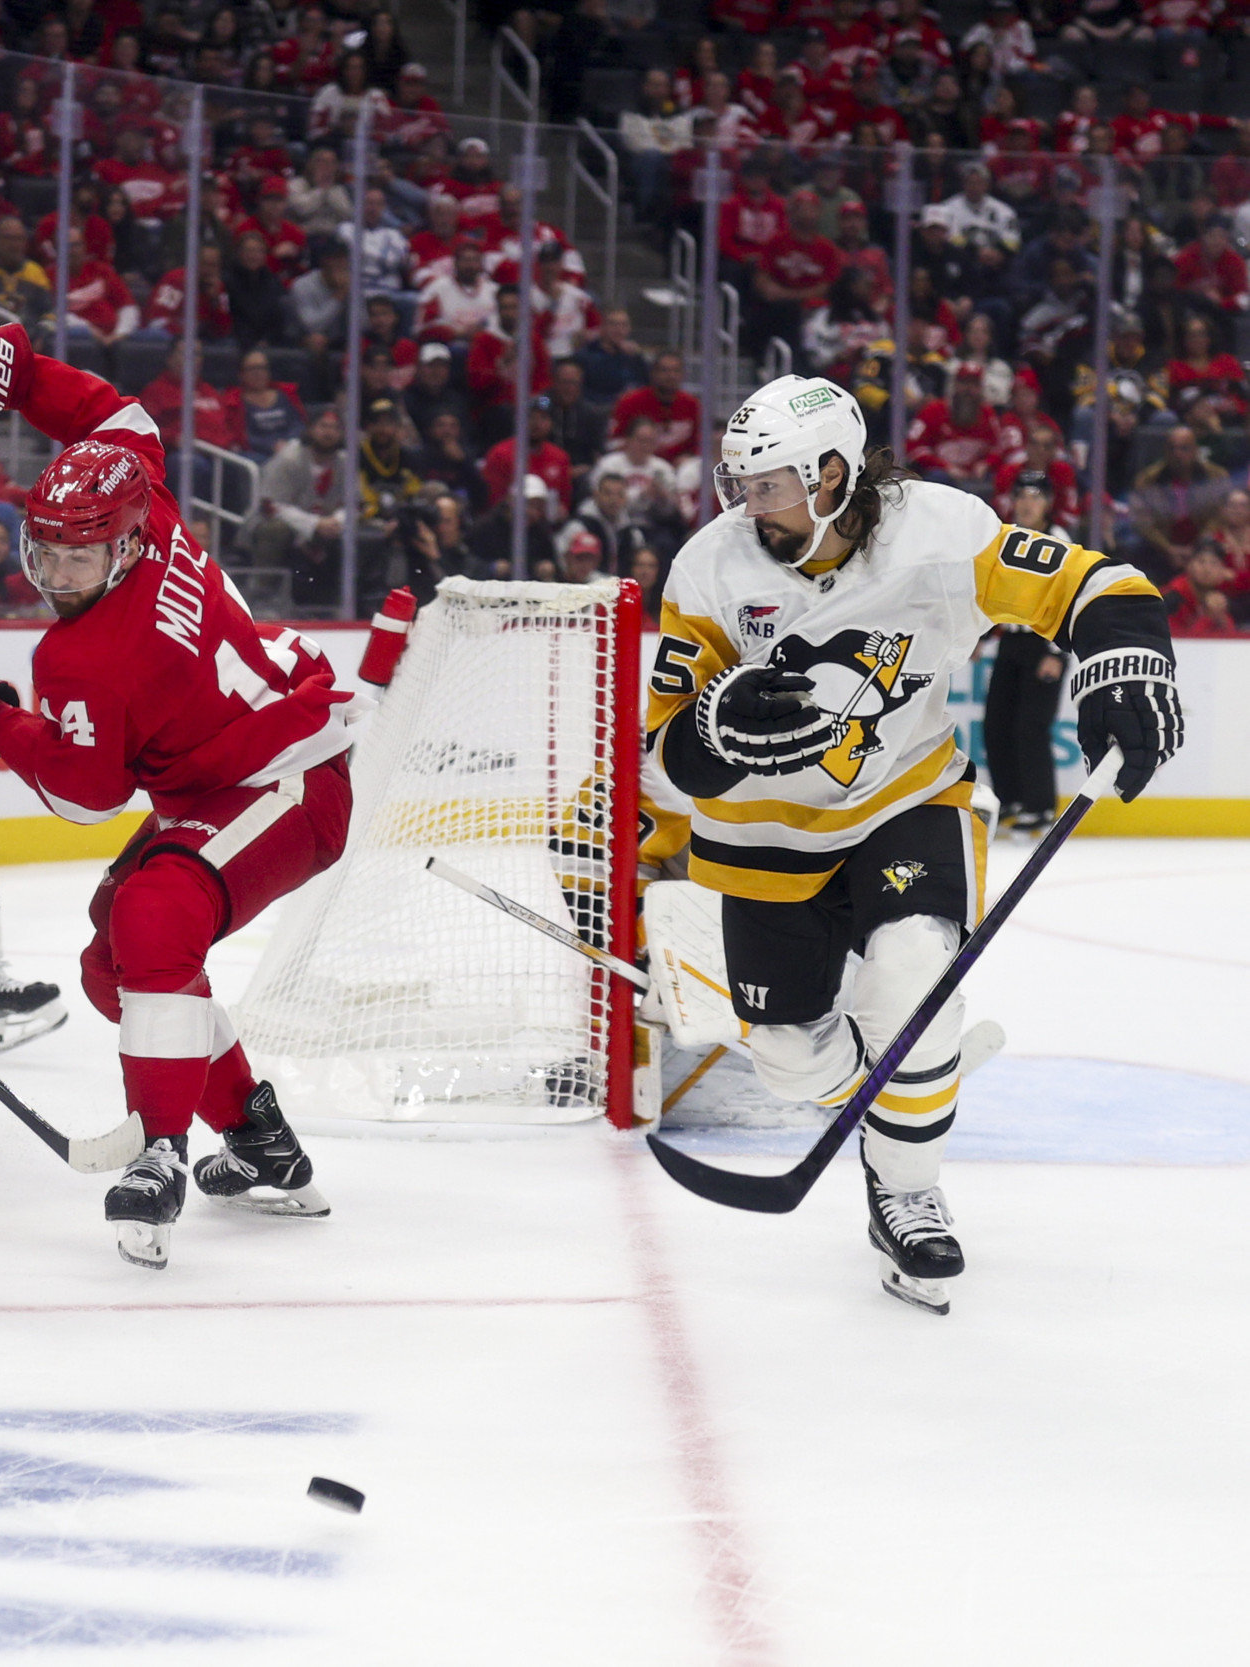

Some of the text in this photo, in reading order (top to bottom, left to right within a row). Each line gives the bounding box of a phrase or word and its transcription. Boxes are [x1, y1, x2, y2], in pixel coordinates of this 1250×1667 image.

[791, 388, 831, 413] MSA
[731, 406, 756, 425] 65
[101, 457, 132, 496] meijer
[46, 482, 71, 504] 14
[33, 515, 64, 528] BAUER
[695, 663, 743, 758] WARRIO
